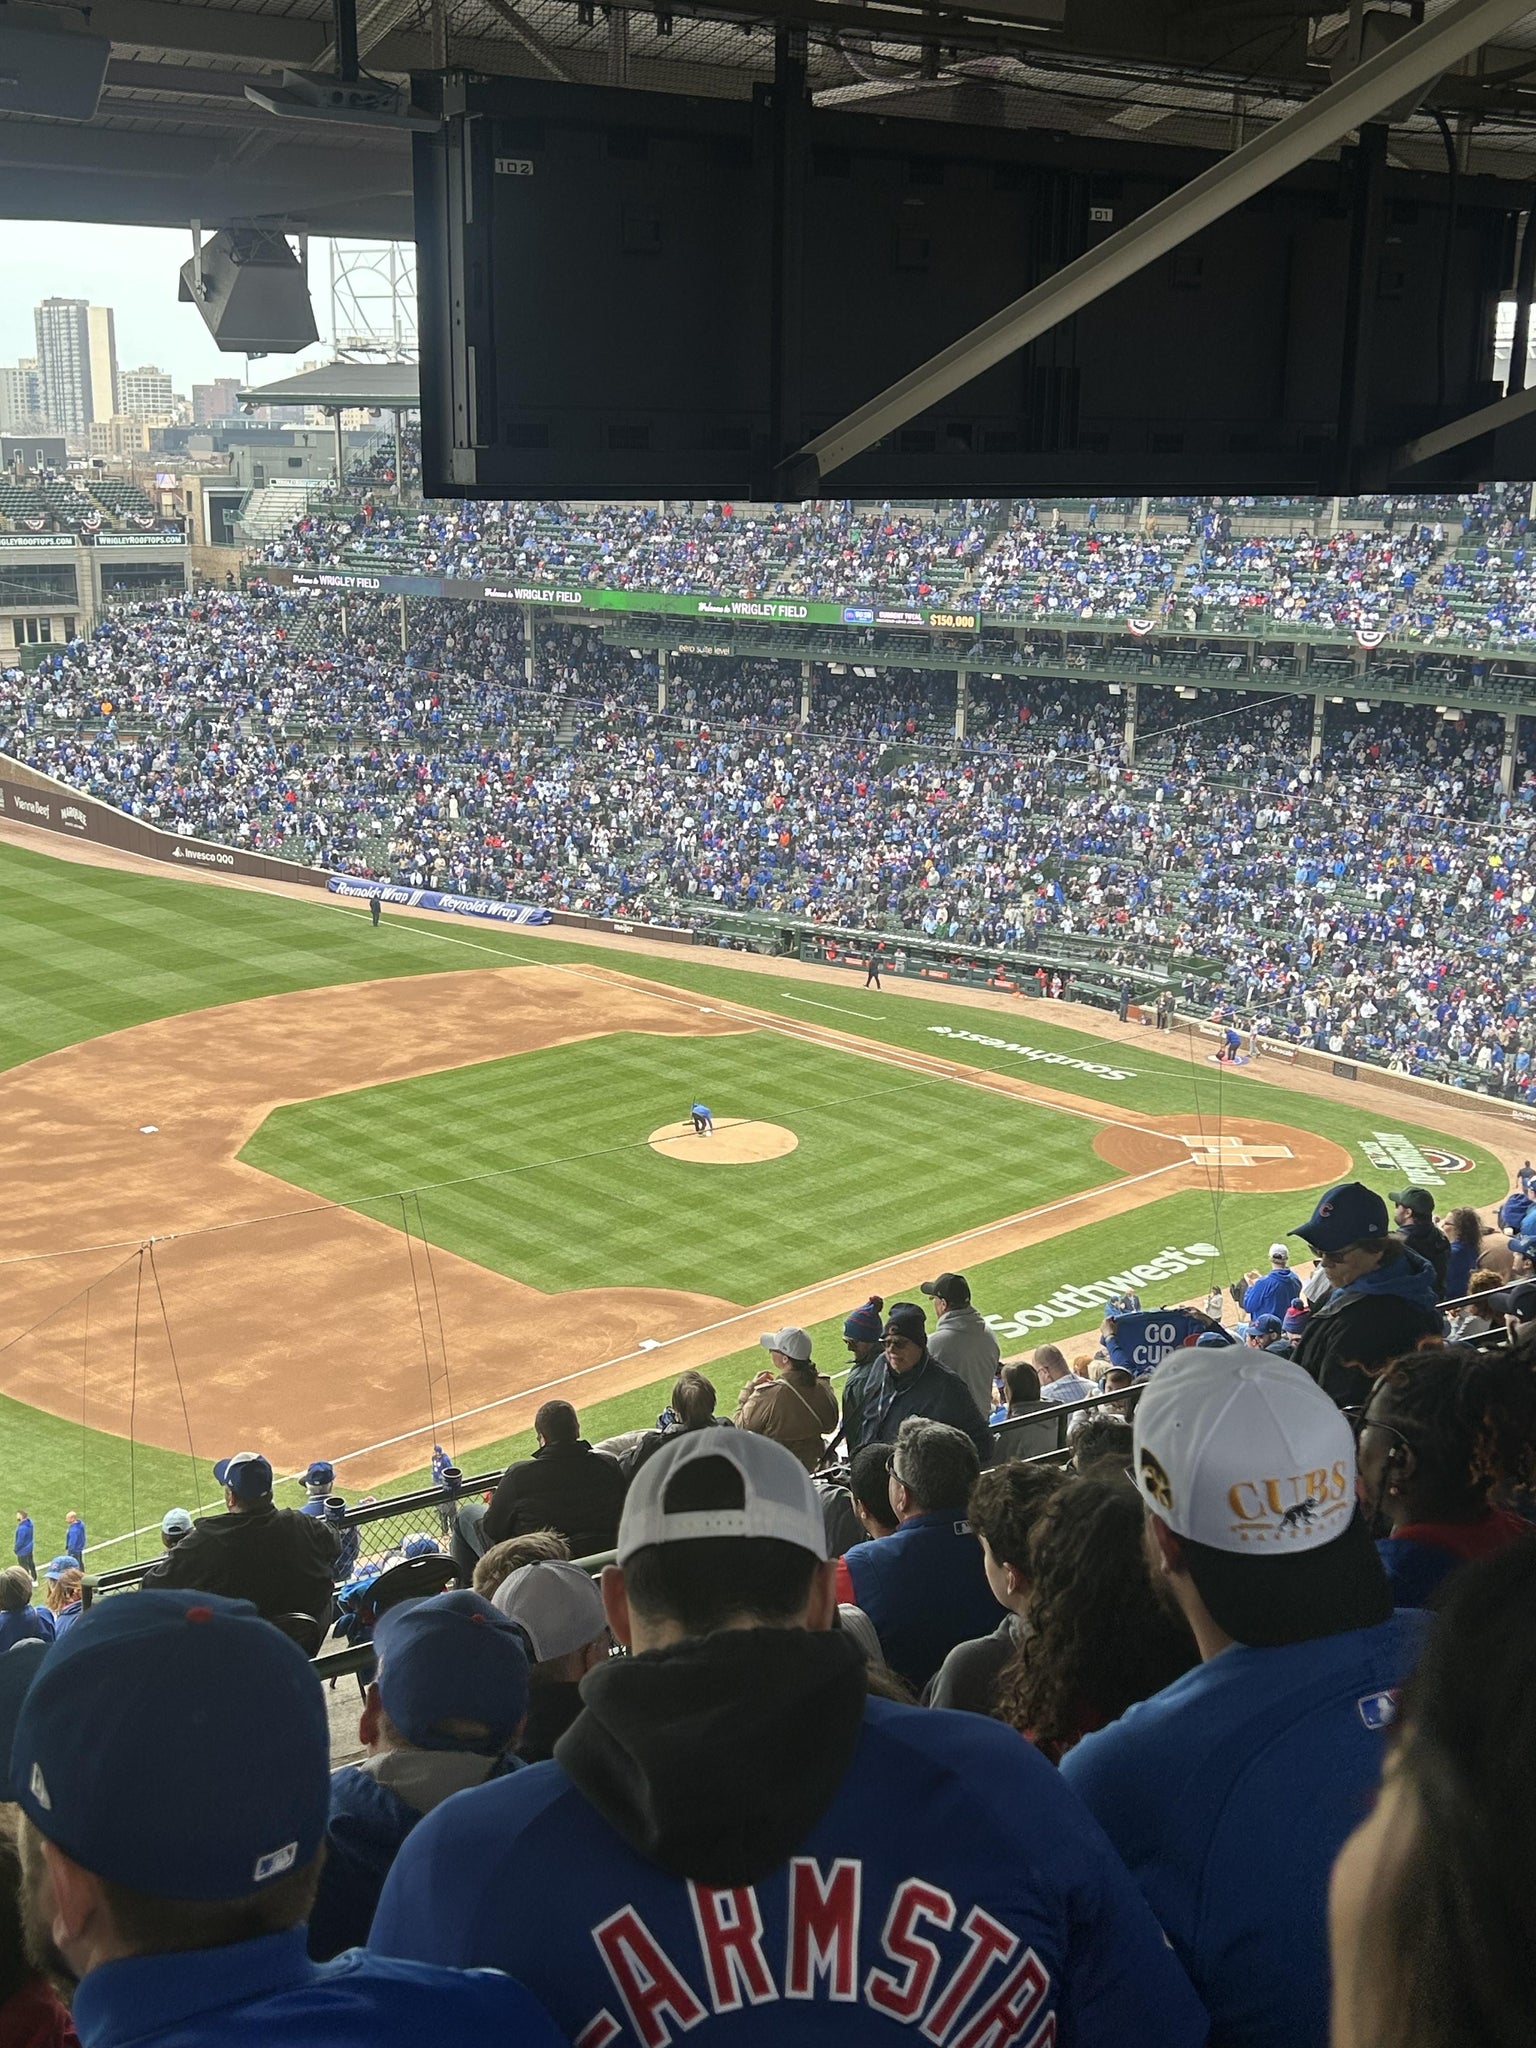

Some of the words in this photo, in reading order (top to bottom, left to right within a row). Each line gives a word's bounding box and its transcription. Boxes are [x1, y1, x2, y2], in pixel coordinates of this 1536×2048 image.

[498, 161, 529, 174] 102
[100, 536, 181, 545] WRIGLEYROOFTOPS.COM
[319, 574, 355, 587] WRIGLEY
[356, 577, 380, 589] FIELD
[514, 588, 555, 601] WRIGLEY
[556, 591, 582, 603] FIELD
[731, 602, 777, 617] WRIGLEY
[778, 605, 808, 618] FIELD
[929, 613, 975, 628] $150,000
[35, 800, 50, 820] Beef
[185, 847, 215, 862] Invesco
[216, 853, 234, 866] QQQ
[381, 886, 409, 906] Wrap
[439, 893, 488, 914] Reynolds
[487, 901, 518, 919] Wrap
[948, 1029, 1138, 1081] Southwest
[1318, 1202, 1334, 1218] C
[985, 1246, 1206, 1340] Southwest
[1144, 1323, 1176, 1344] GO
[1227, 1460, 1346, 1521] CUBS
